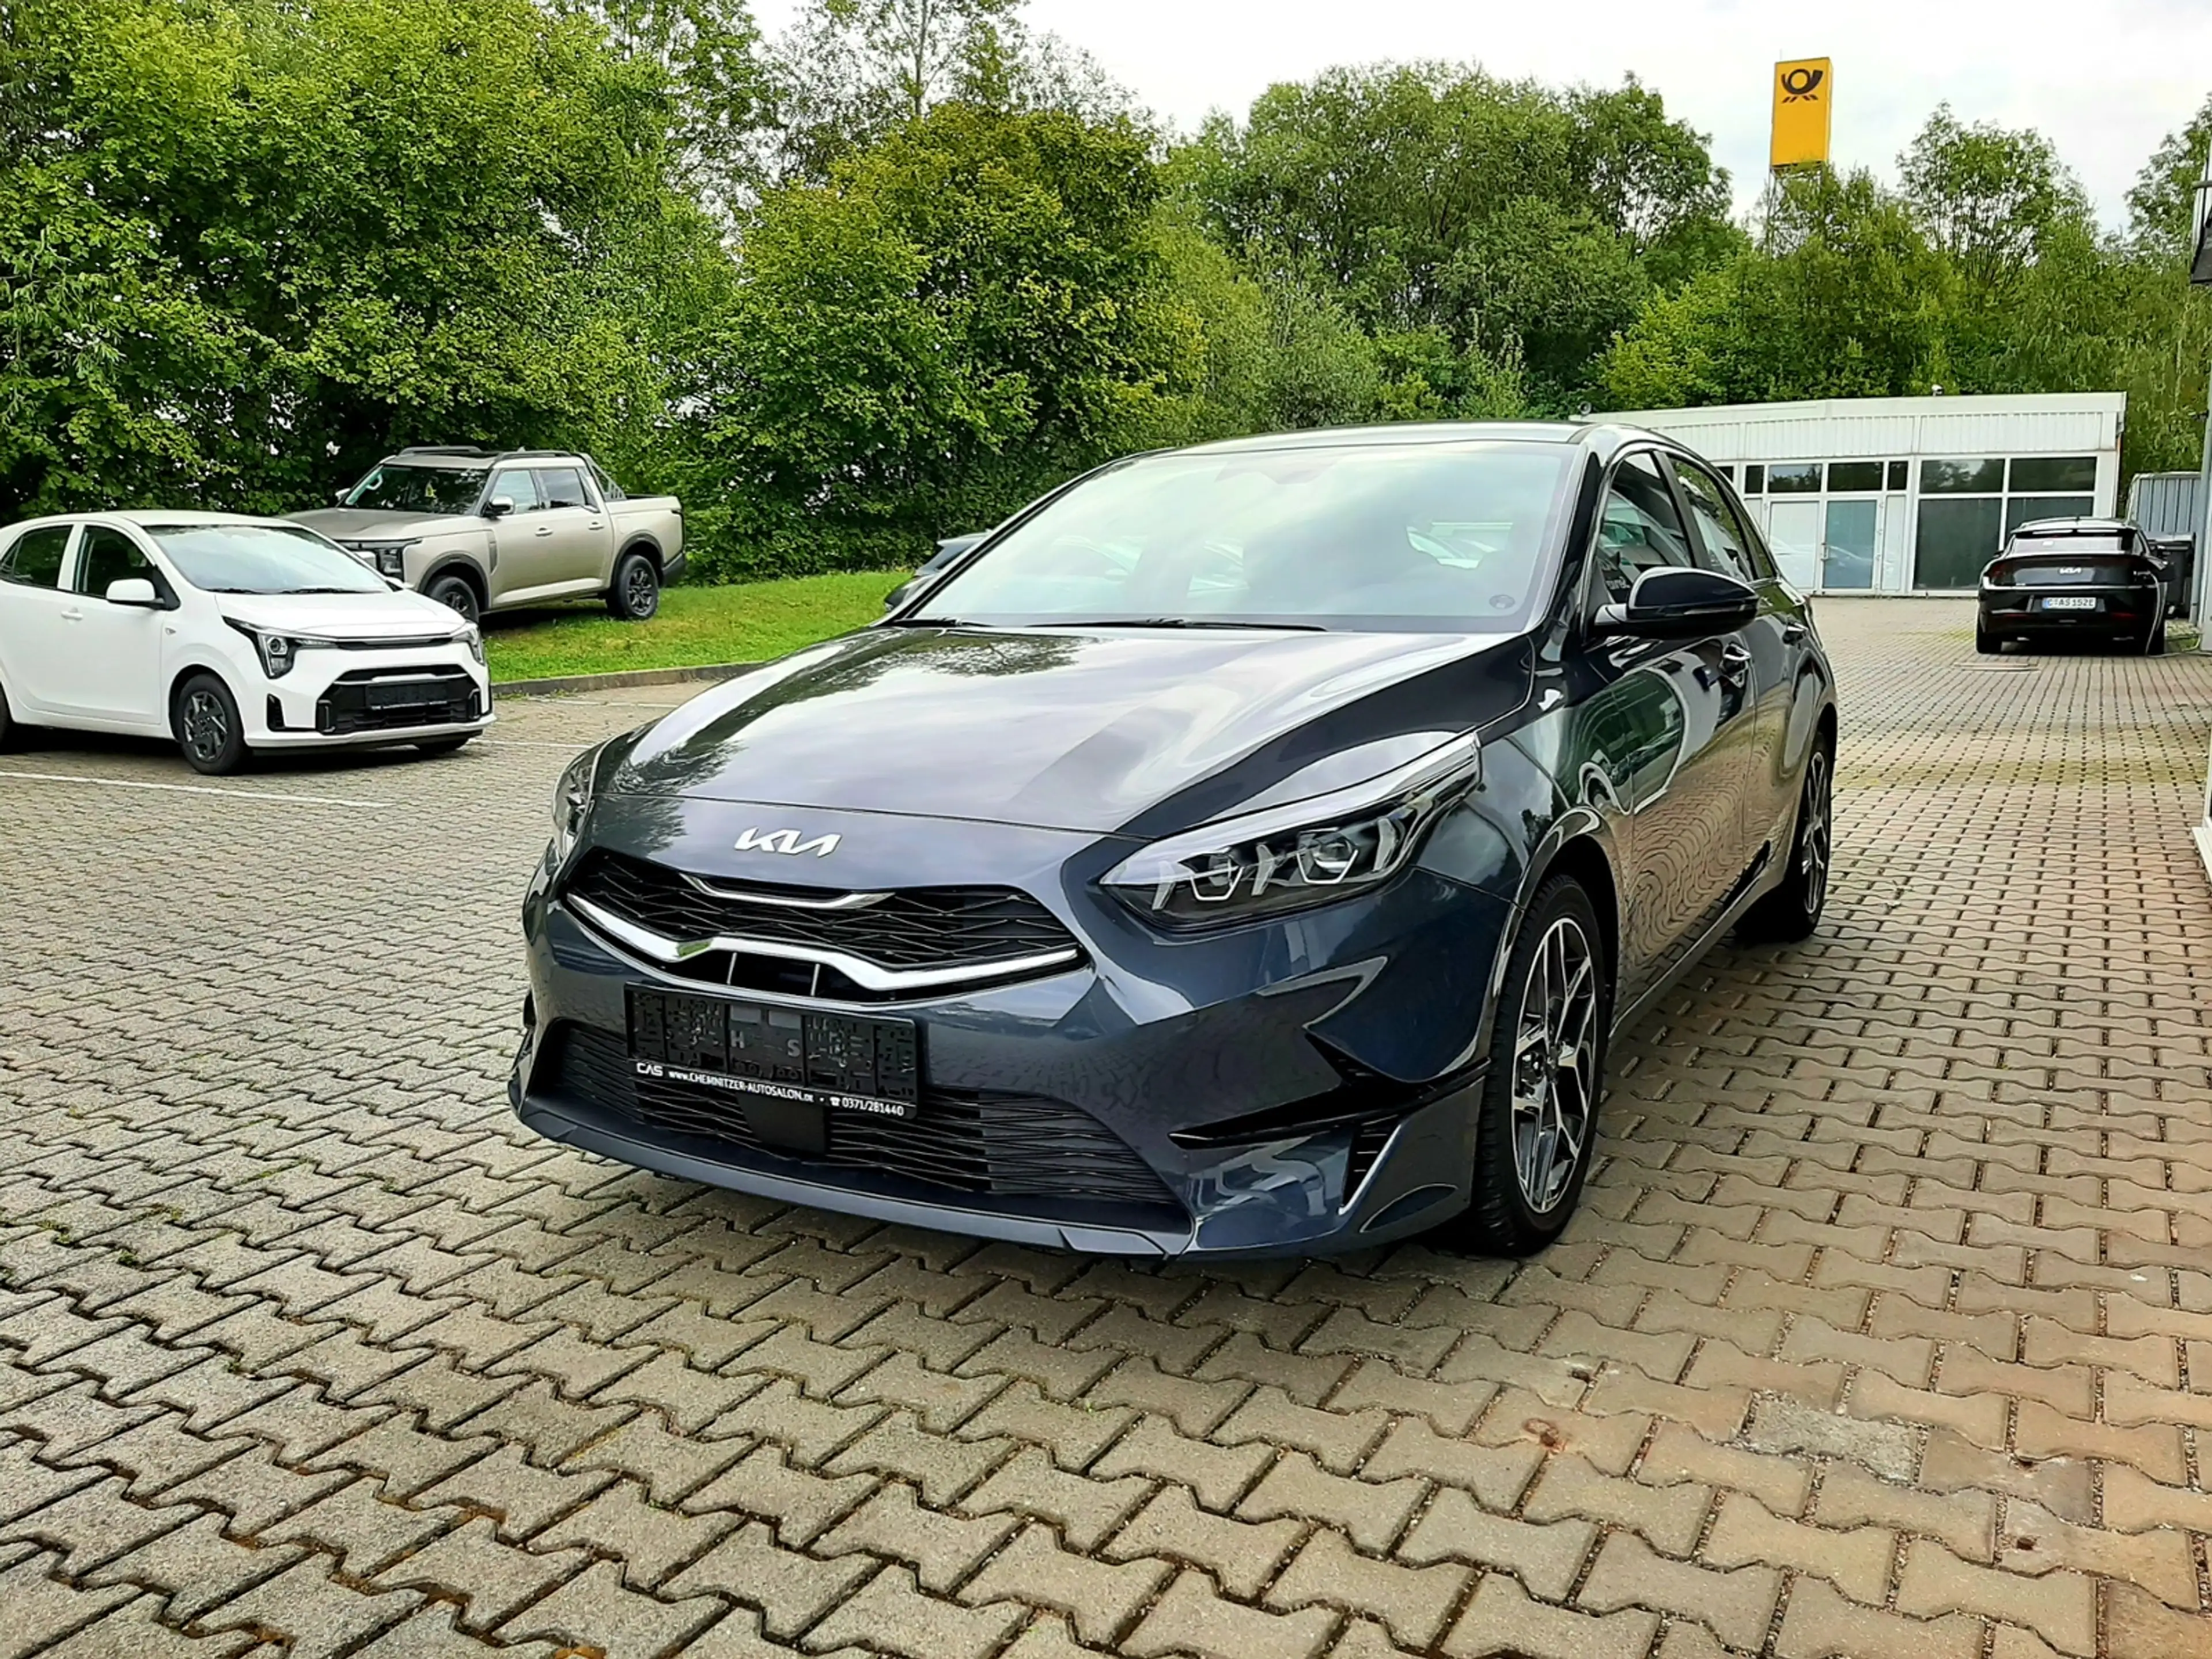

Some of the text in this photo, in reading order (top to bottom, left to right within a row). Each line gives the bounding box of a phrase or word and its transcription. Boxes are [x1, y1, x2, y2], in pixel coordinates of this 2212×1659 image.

[734, 826, 842, 858] KIA
[637, 1063, 663, 1077] CAS
[842, 1097, 904, 1116] 0371/281440
